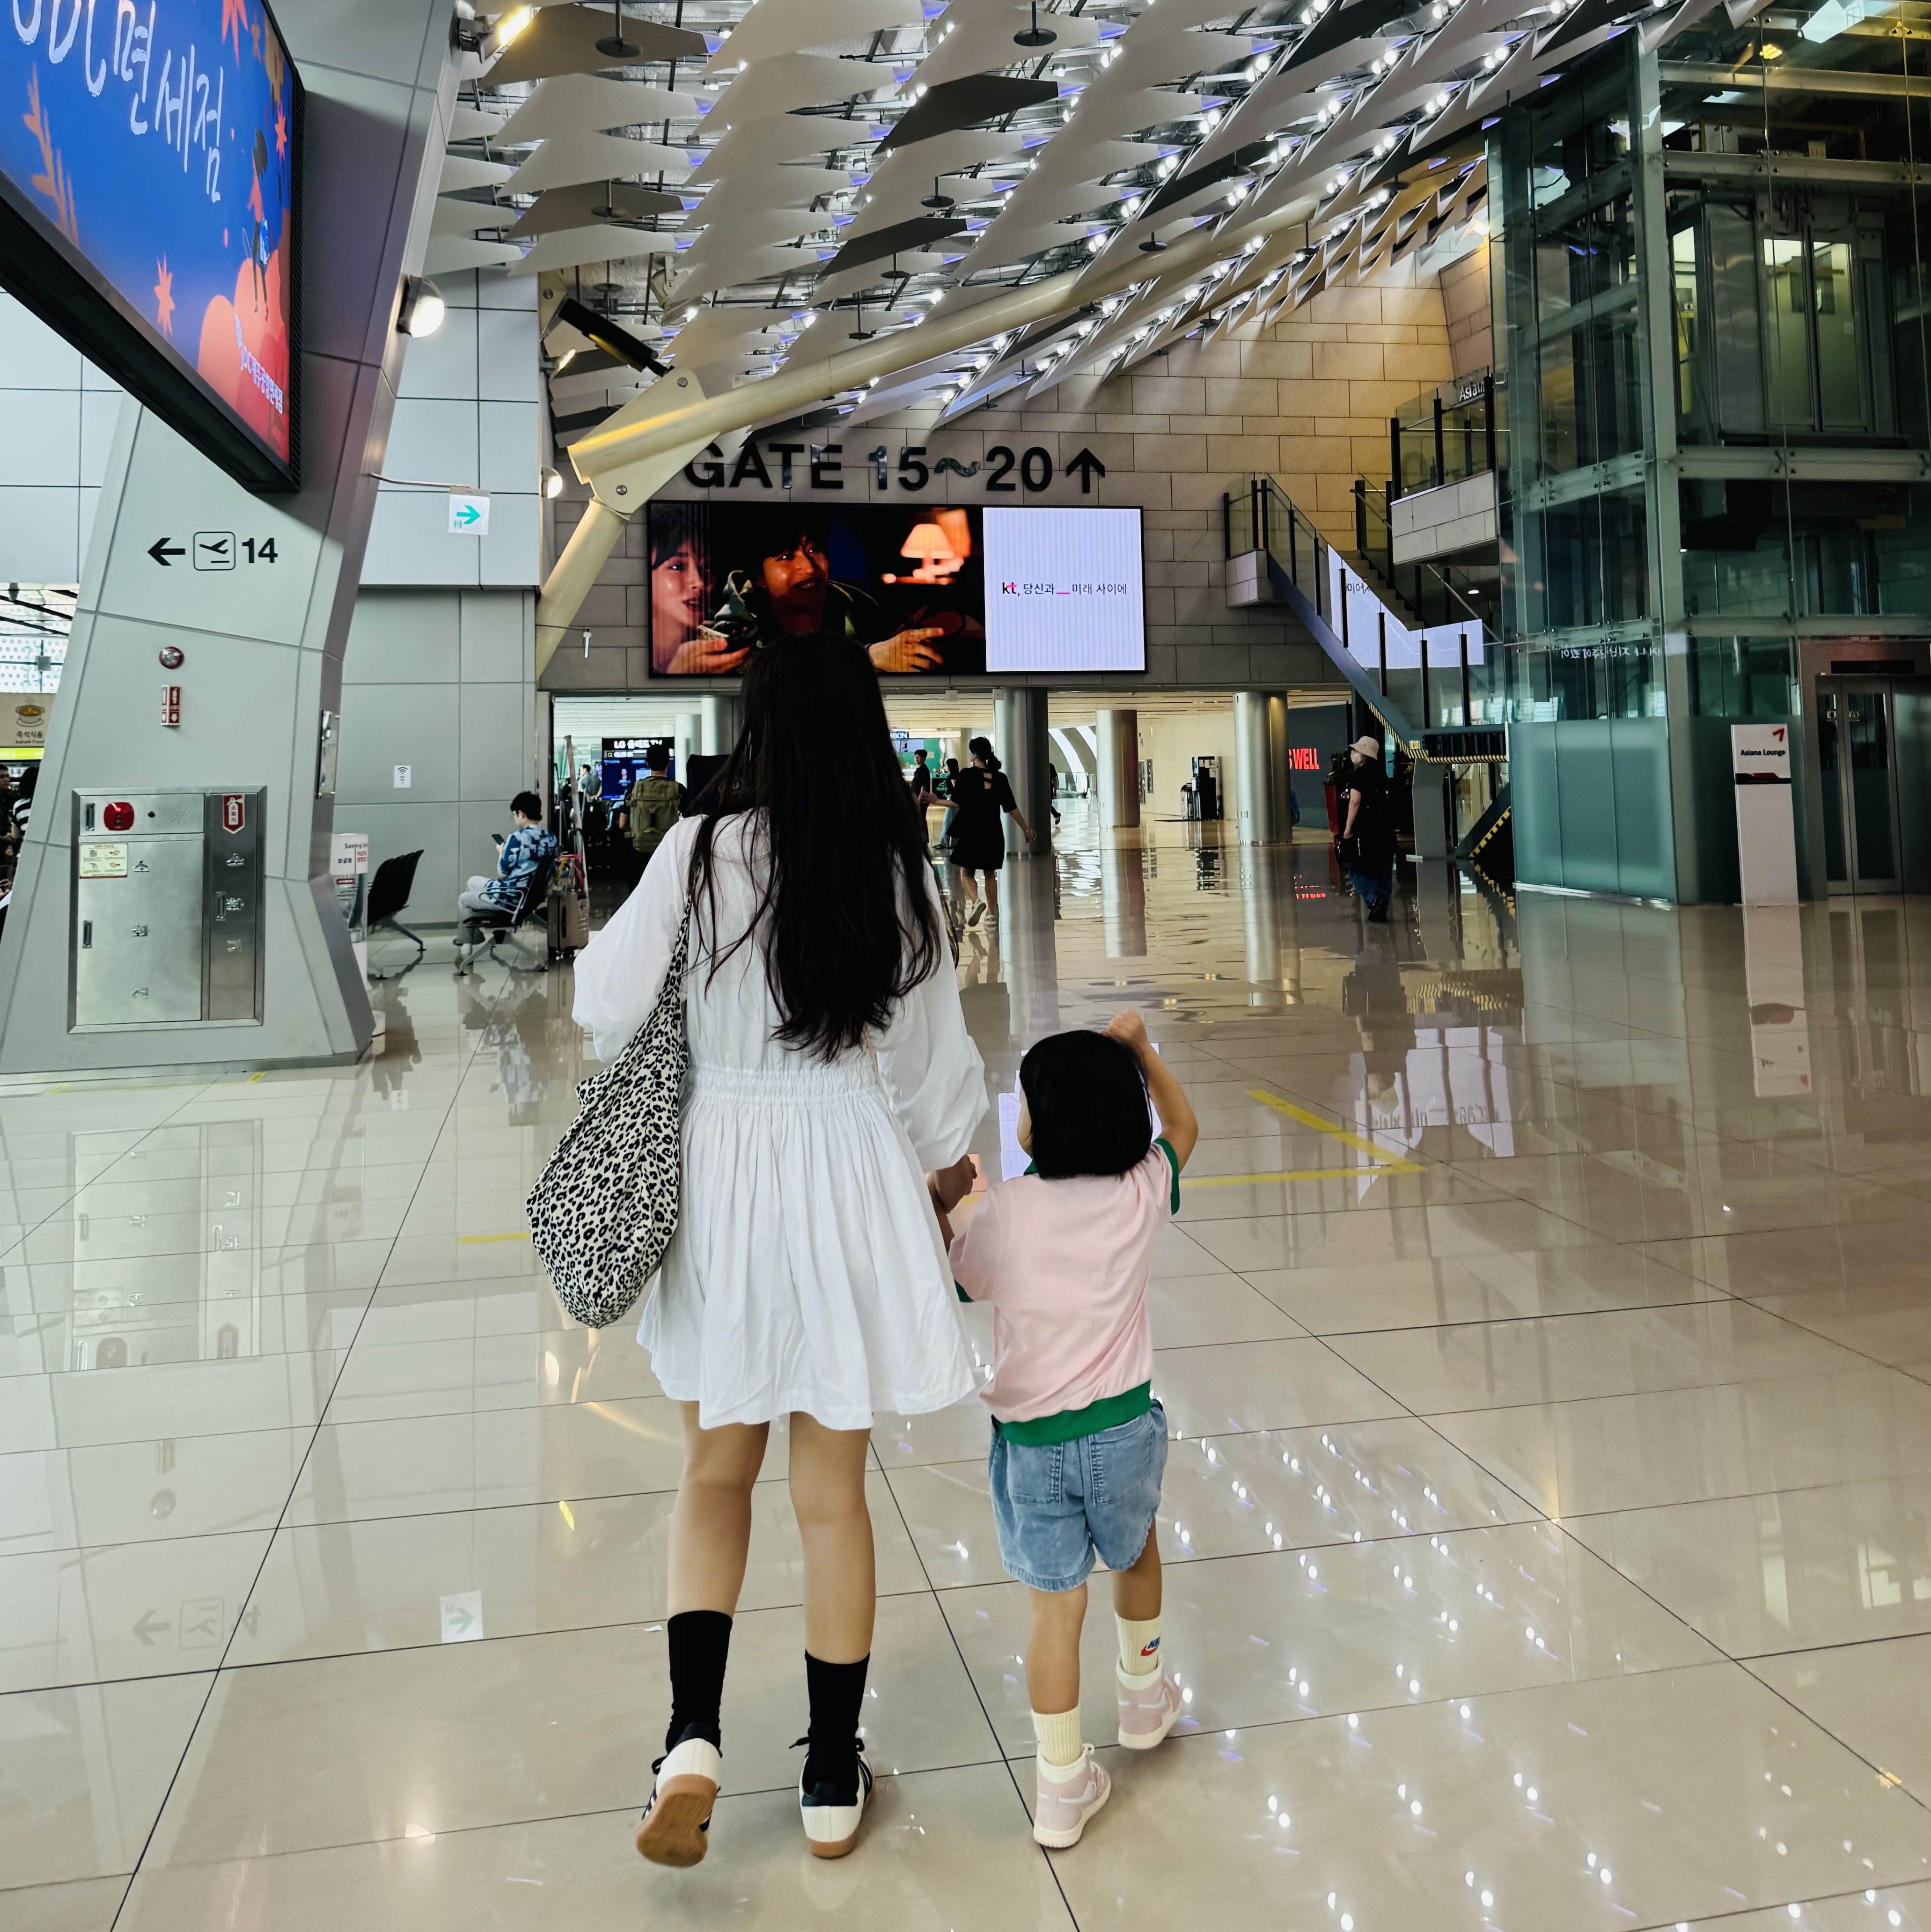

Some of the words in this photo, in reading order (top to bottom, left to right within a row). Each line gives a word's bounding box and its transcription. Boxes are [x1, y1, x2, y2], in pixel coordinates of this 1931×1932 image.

[684, 443, 843, 489] GATE
[242, 537, 279, 564] 14
[1023, 583, 1055, 595] 당신과
[1072, 583, 1092, 595] 미래
[1096, 583, 1127, 595] 사이에
